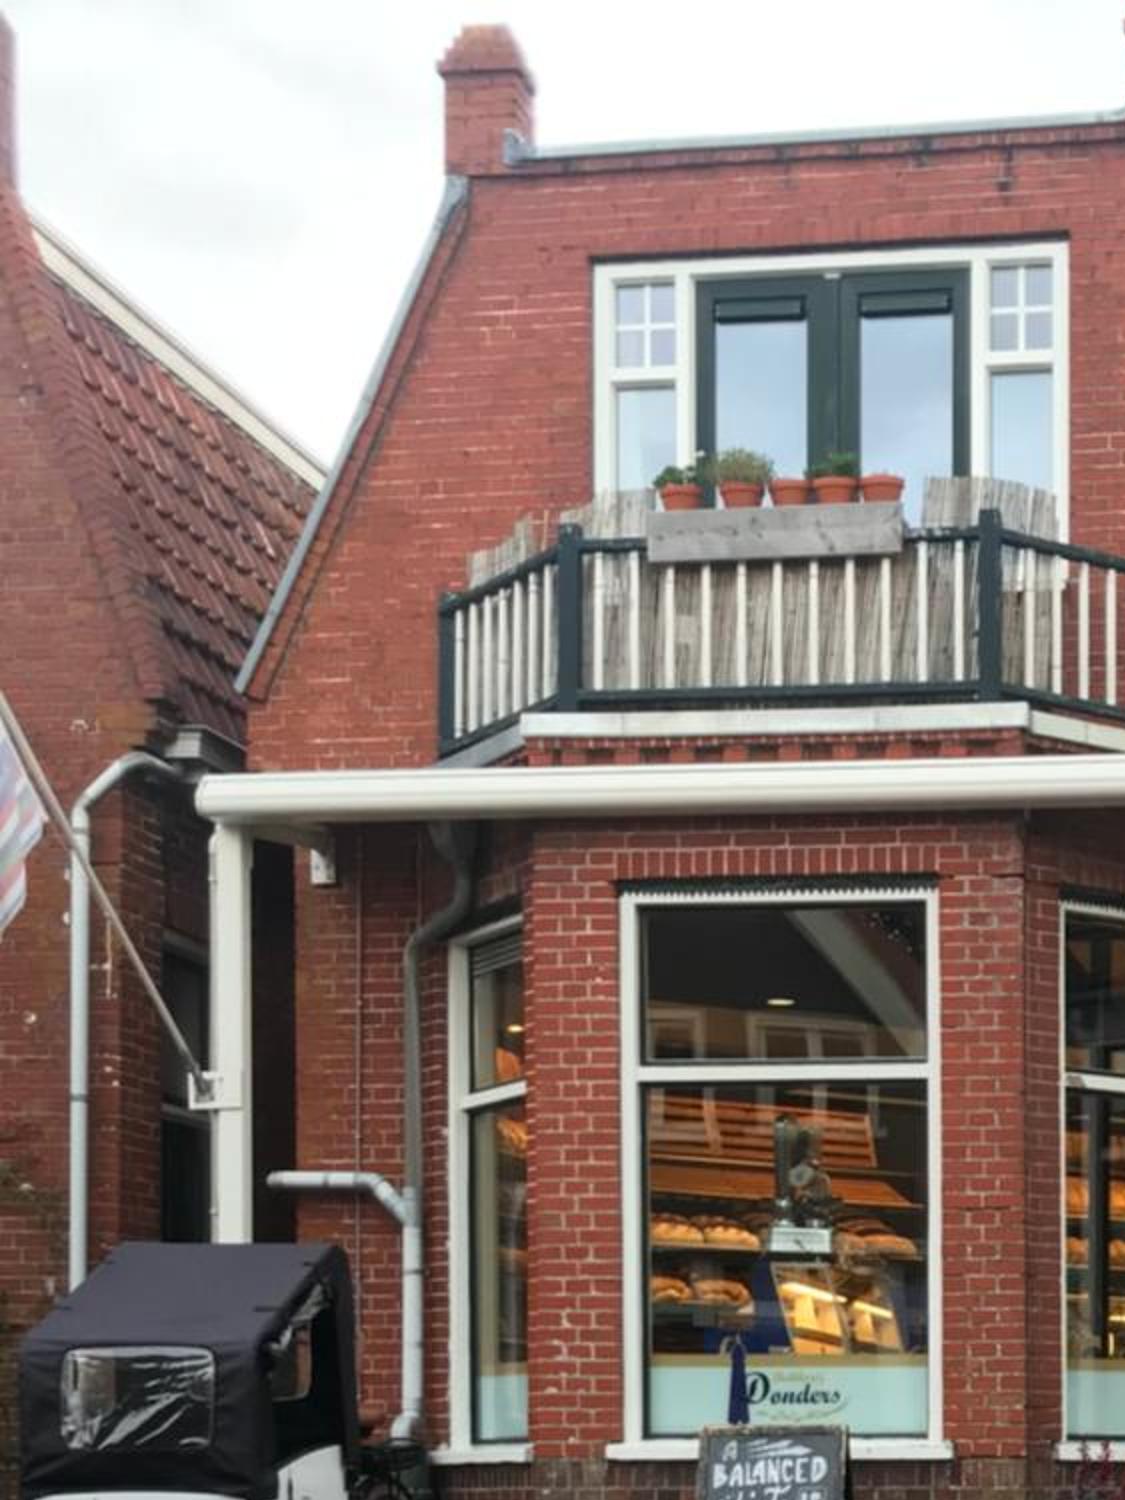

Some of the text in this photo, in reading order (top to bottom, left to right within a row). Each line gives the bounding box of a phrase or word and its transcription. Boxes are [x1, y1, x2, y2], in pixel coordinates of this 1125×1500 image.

[746, 1370, 841, 1405] Donders
[722, 1441, 738, 1461] A
[712, 1456, 829, 1489] BALANCED
